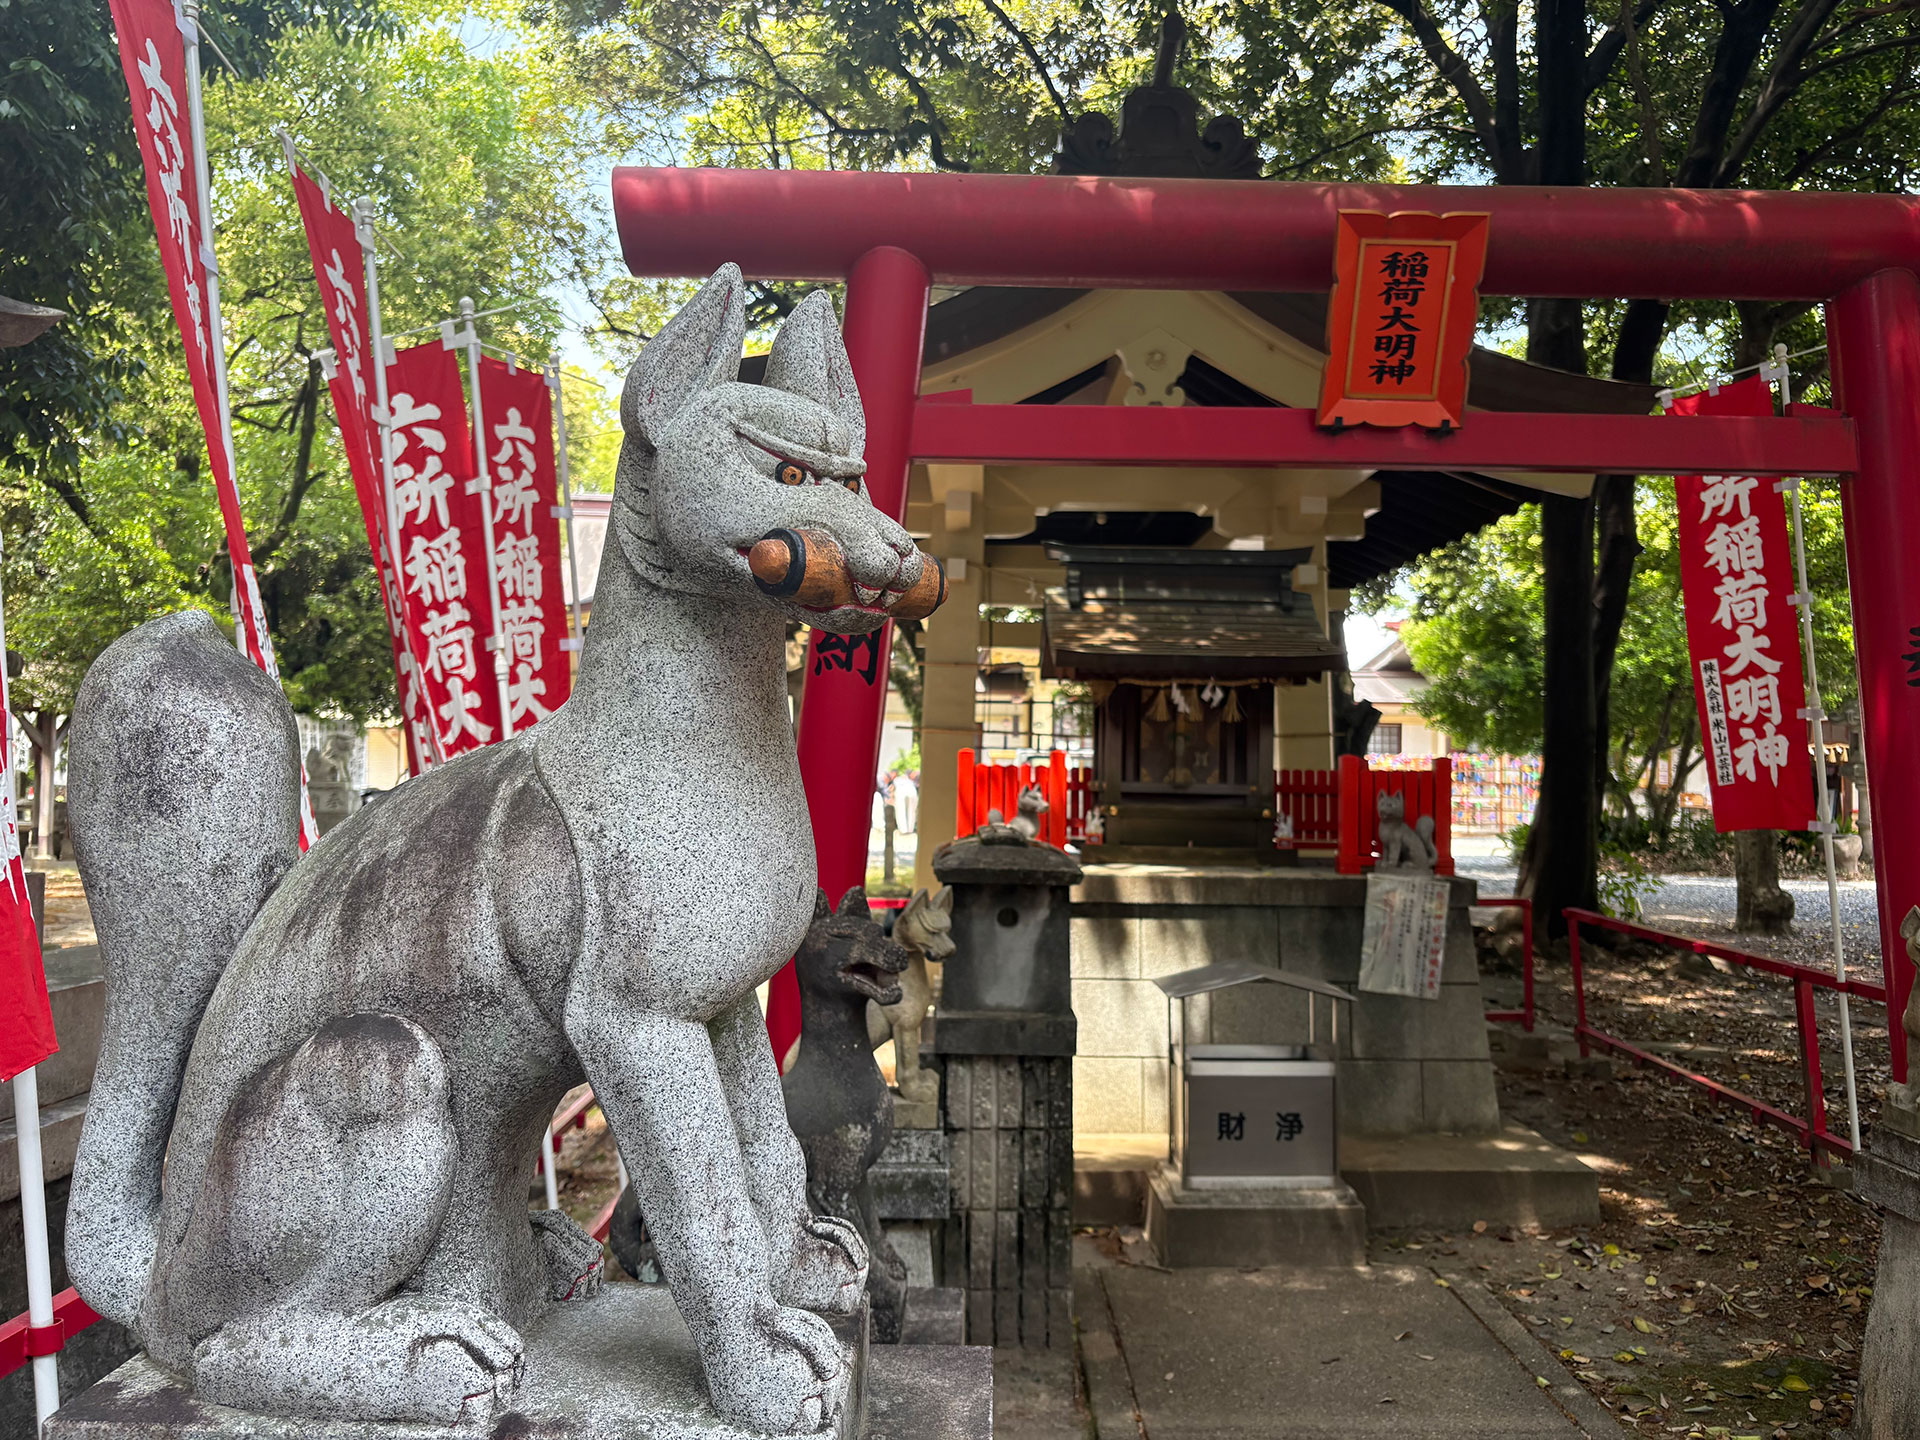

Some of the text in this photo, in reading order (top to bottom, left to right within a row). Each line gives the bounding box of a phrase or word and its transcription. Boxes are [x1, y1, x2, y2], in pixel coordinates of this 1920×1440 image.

[1368, 251, 1430, 386] 稲荷大明神
[379, 391, 495, 757] 六所稲荷大
[491, 406, 551, 737] 六所稲荷大
[1702, 661, 1724, 714] 株式会社
